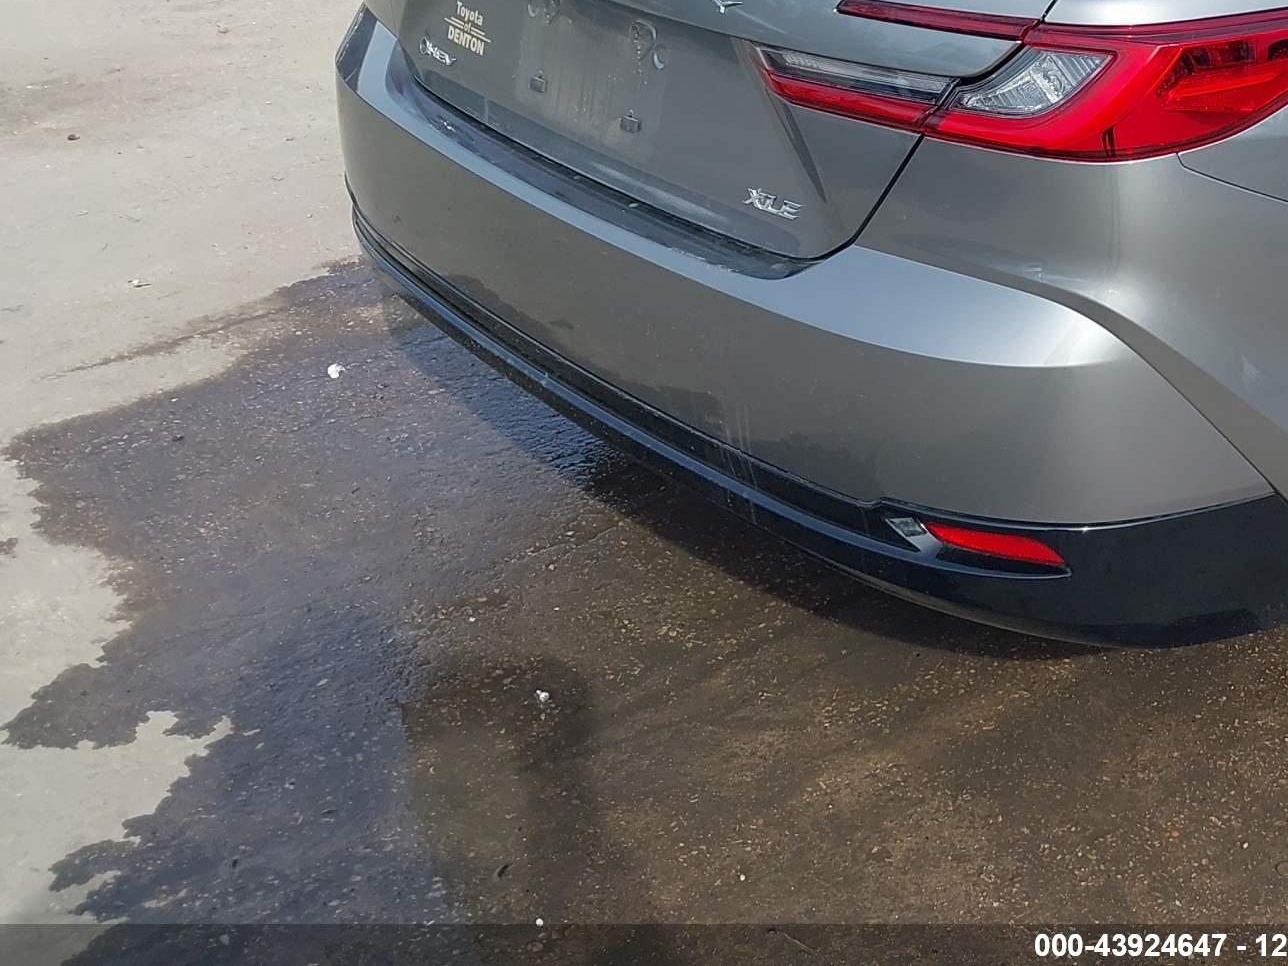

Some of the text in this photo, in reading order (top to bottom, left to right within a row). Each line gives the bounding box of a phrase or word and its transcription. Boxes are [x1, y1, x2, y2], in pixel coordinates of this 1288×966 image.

[456, 0, 484, 26] Toyota
[447, 25, 485, 56] DENTON
[463, 22, 472, 33] of
[742, 187, 803, 221] XLE
